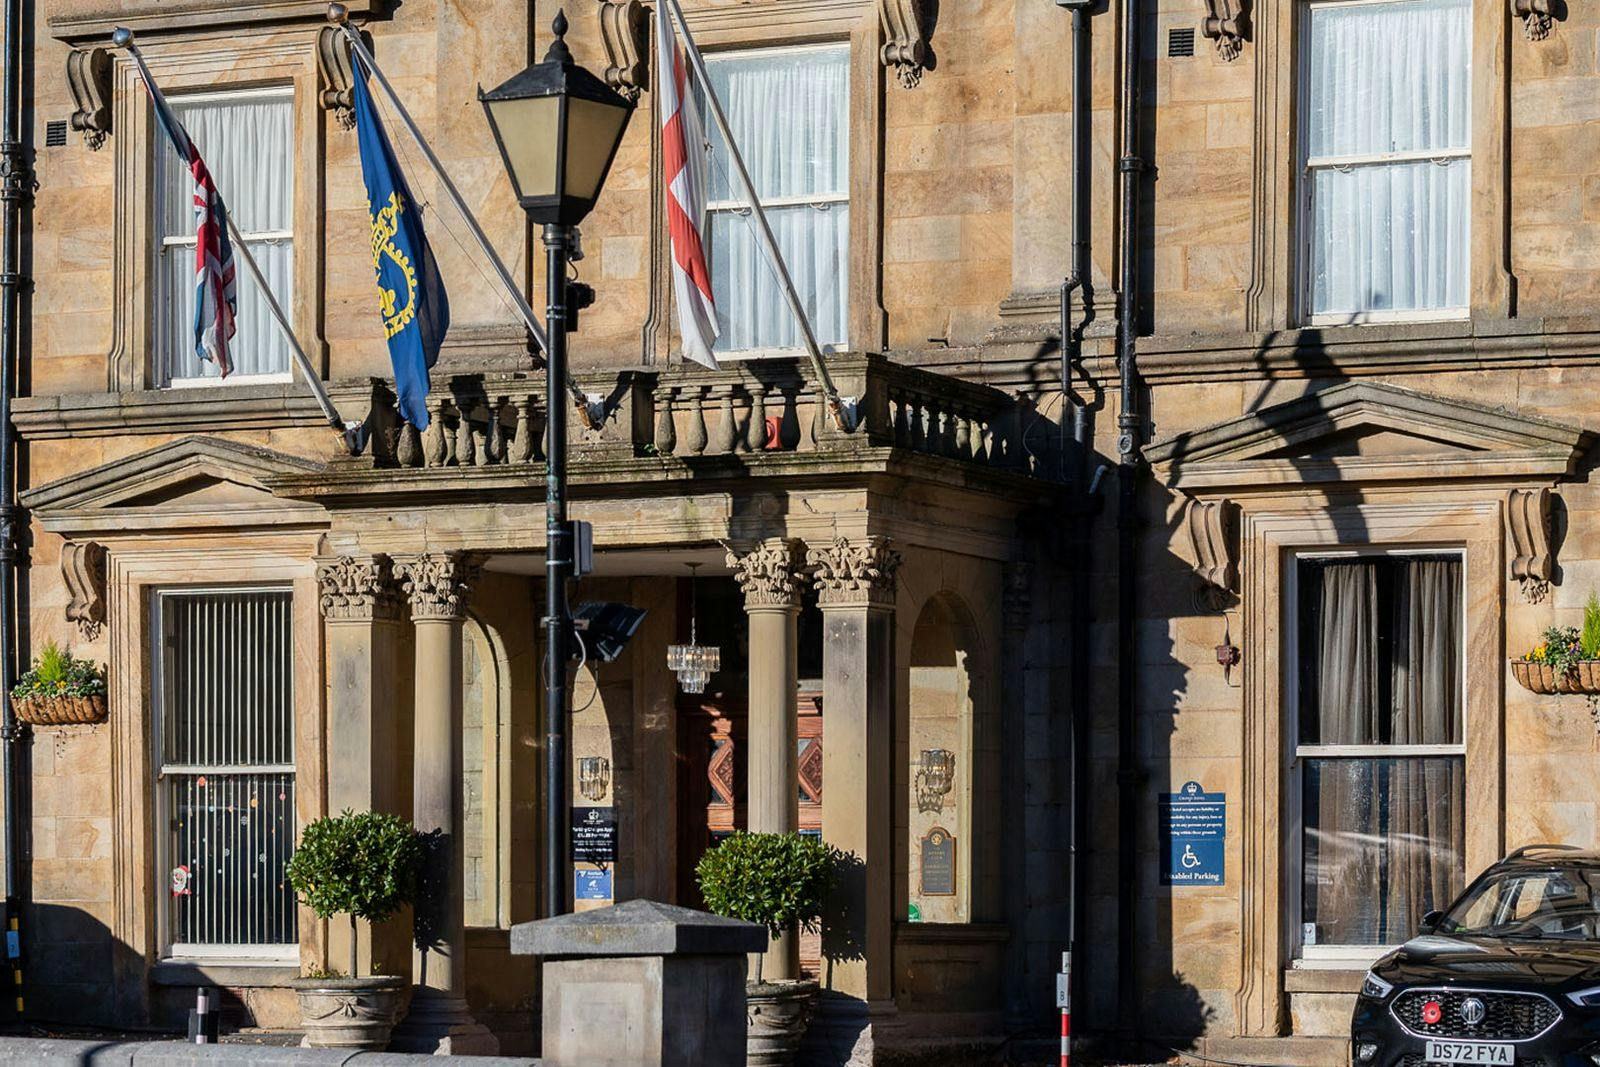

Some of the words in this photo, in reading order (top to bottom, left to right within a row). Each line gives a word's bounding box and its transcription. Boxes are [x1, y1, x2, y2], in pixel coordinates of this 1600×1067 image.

[1194, 872, 1220, 882] Parking
[1432, 1044, 1472, 1060] DS72
[1477, 1045, 1507, 1062] FYA
